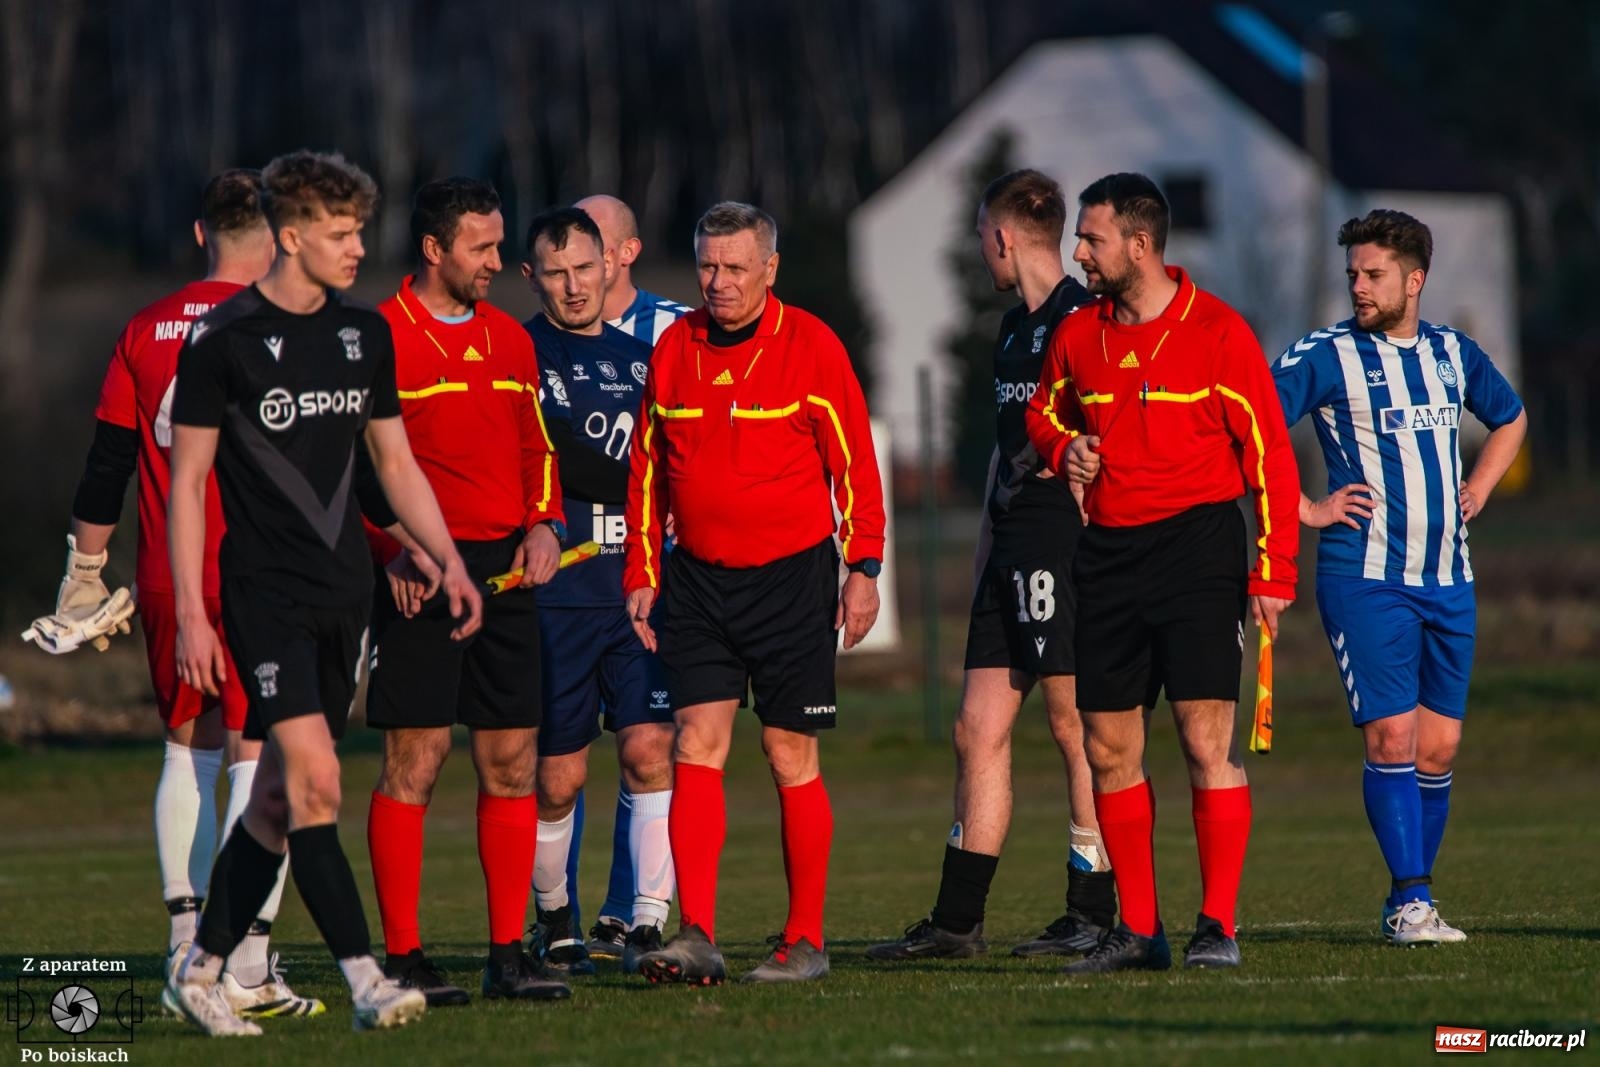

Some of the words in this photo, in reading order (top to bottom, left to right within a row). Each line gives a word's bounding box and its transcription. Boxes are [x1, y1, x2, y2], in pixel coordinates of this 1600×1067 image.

[1000, 382, 1040, 403] SPOR
[1411, 407, 1456, 428] AMT
[1013, 569, 1056, 622] 18
